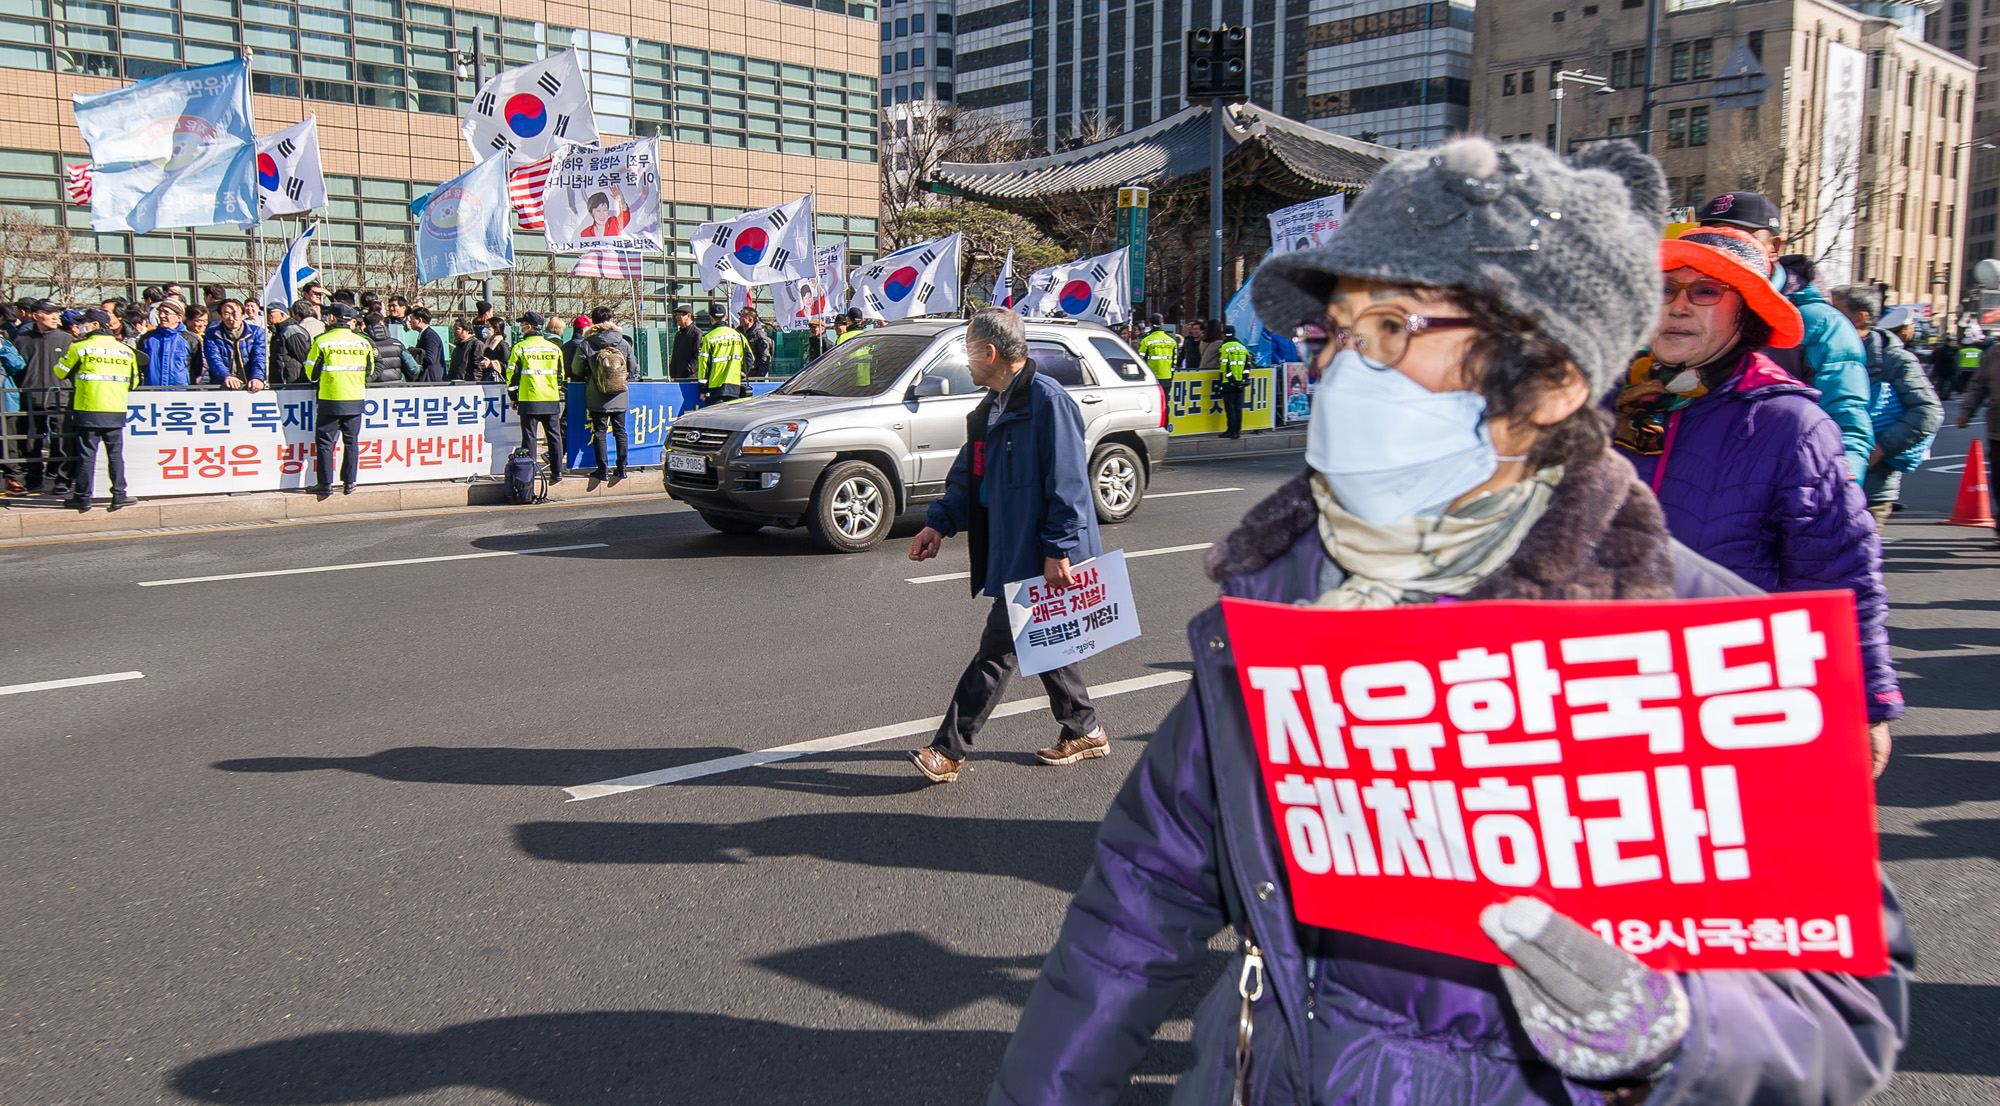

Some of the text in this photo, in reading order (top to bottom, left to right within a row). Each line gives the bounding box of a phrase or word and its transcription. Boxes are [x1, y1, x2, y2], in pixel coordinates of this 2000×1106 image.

[88, 356, 129, 366] POLICE
[125, 394, 509, 436] 잔혹한 독재 인권말살자
[157, 444, 262, 480] 김정은
[358, 434, 483, 470] 결사반대!
[685, 457, 702, 471] 9005
[1027, 602, 1119, 648] 특별법 개정!
[1032, 583, 1106, 624] 왜곡 처벌!
[1247, 608, 1827, 774] 자유한국당
[1275, 765, 1751, 891] 해체하라!
